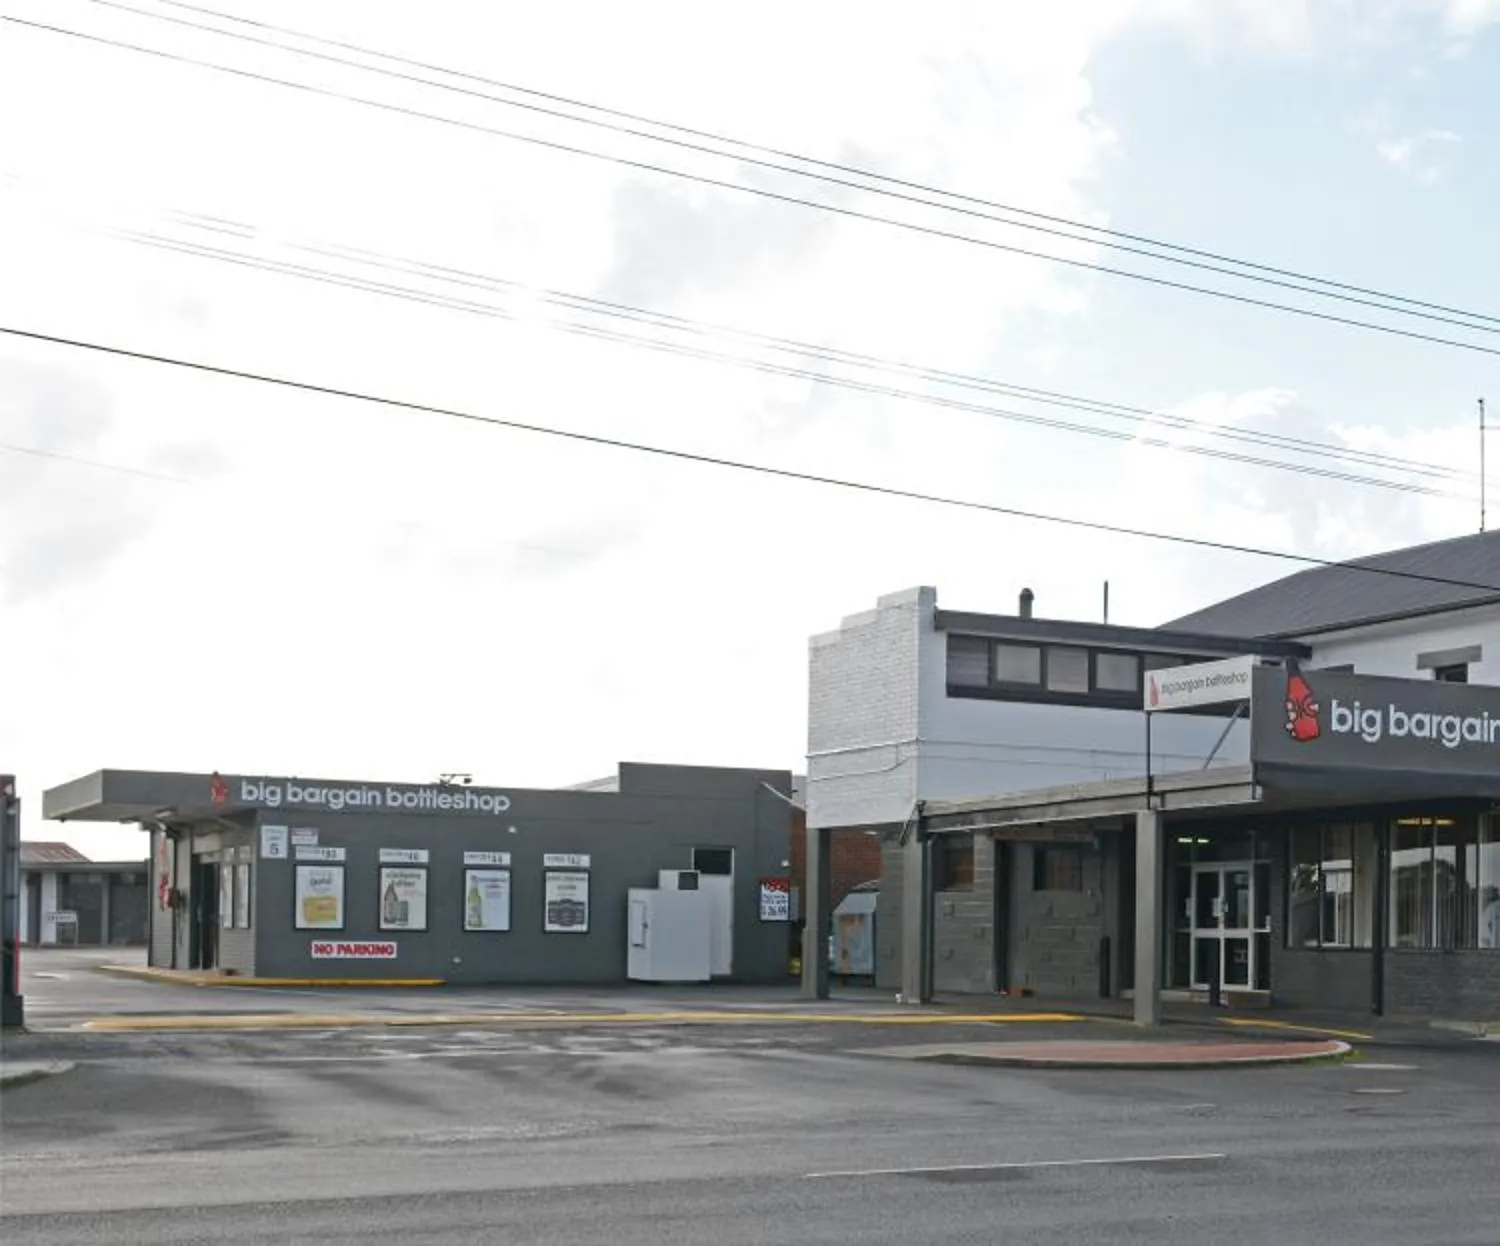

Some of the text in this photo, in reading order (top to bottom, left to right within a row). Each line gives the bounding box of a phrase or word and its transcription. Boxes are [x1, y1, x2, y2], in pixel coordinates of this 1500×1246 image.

[1331, 700, 1382, 742] big
[241, 779, 511, 815] big bargain bottleshop
[314, 943, 394, 956] NO PARKING
